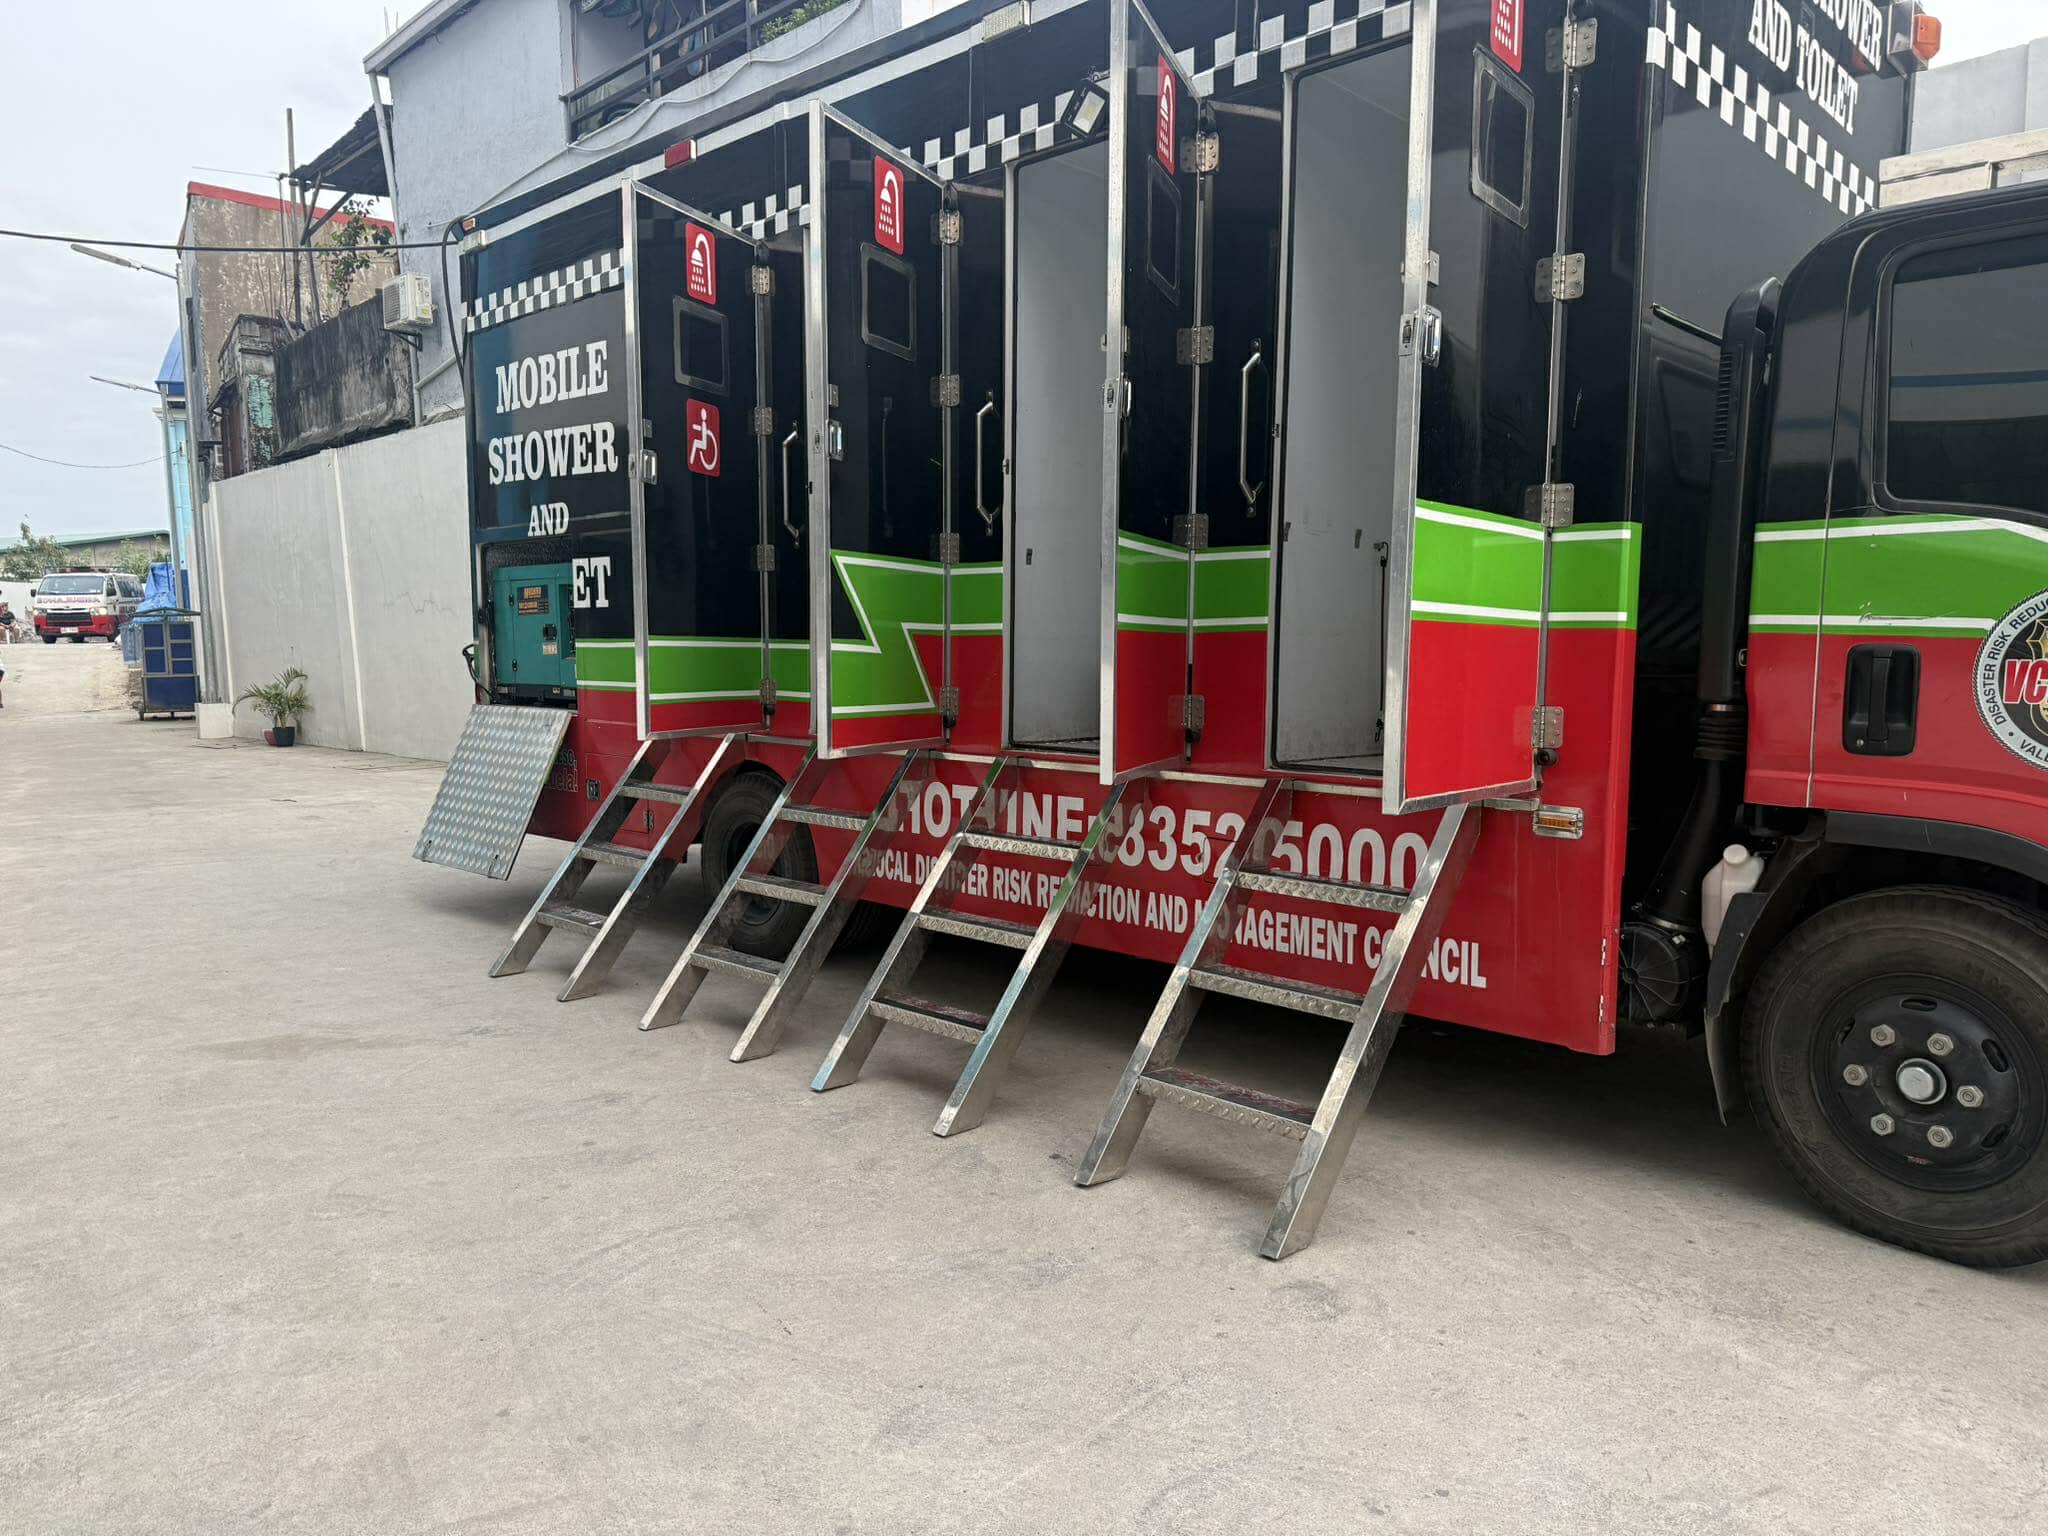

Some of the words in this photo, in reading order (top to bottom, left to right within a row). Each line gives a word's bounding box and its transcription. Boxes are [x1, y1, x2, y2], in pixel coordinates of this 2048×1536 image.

[1748, 0, 1792, 72] AND
[1796, 24, 1859, 135] TOILET
[496, 340, 608, 414] MOBILE
[488, 421, 618, 485] SHOWER
[528, 502, 569, 537] AND
[1987, 630, 2011, 660] RISK
[2009, 598, 2048, 630] REDU
[1983, 663, 2007, 726] DISASTER
[992, 865, 1034, 906] RISK
[1037, 873, 1140, 927] RETION
[1144, 891, 1188, 934] AND
